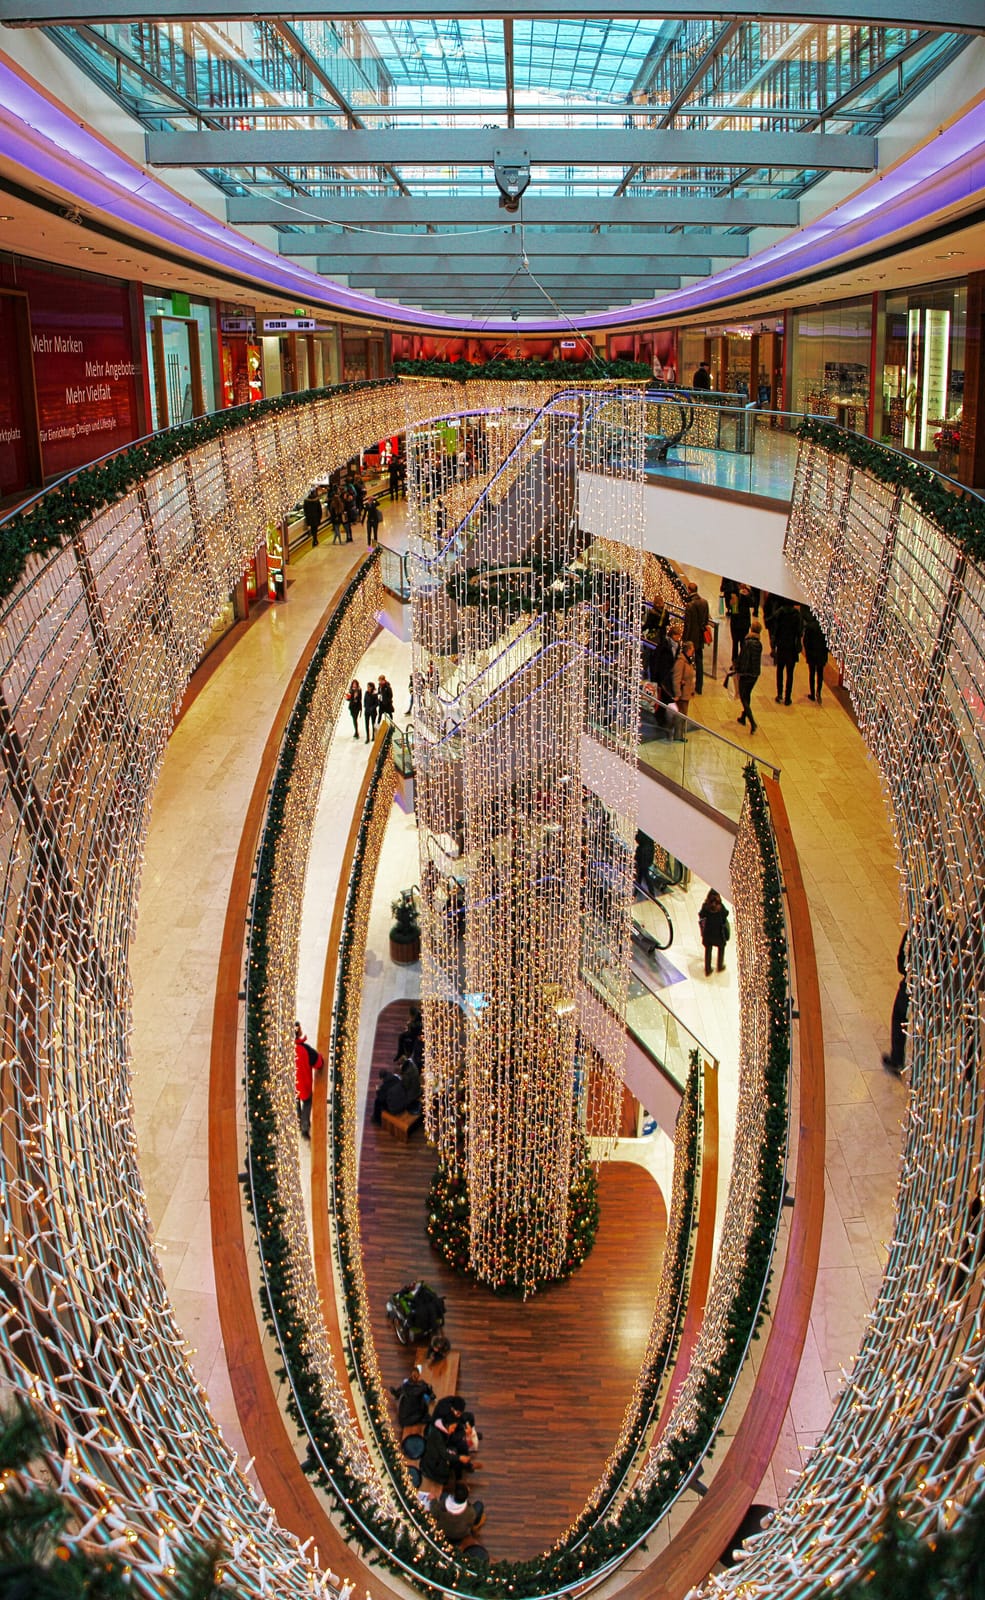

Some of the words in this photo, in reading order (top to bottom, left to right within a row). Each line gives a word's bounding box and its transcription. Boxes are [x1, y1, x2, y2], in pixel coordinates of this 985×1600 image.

[31, 334, 52, 353] Mehr
[54, 336, 84, 353] Marken
[85, 361, 104, 377] Mehr
[105, 361, 135, 381] Angebote
[66, 387, 86, 405] Mehr
[86, 384, 112, 402] Vielfalt
[76, 421, 91, 435] Design
[91, 420, 101, 430] und
